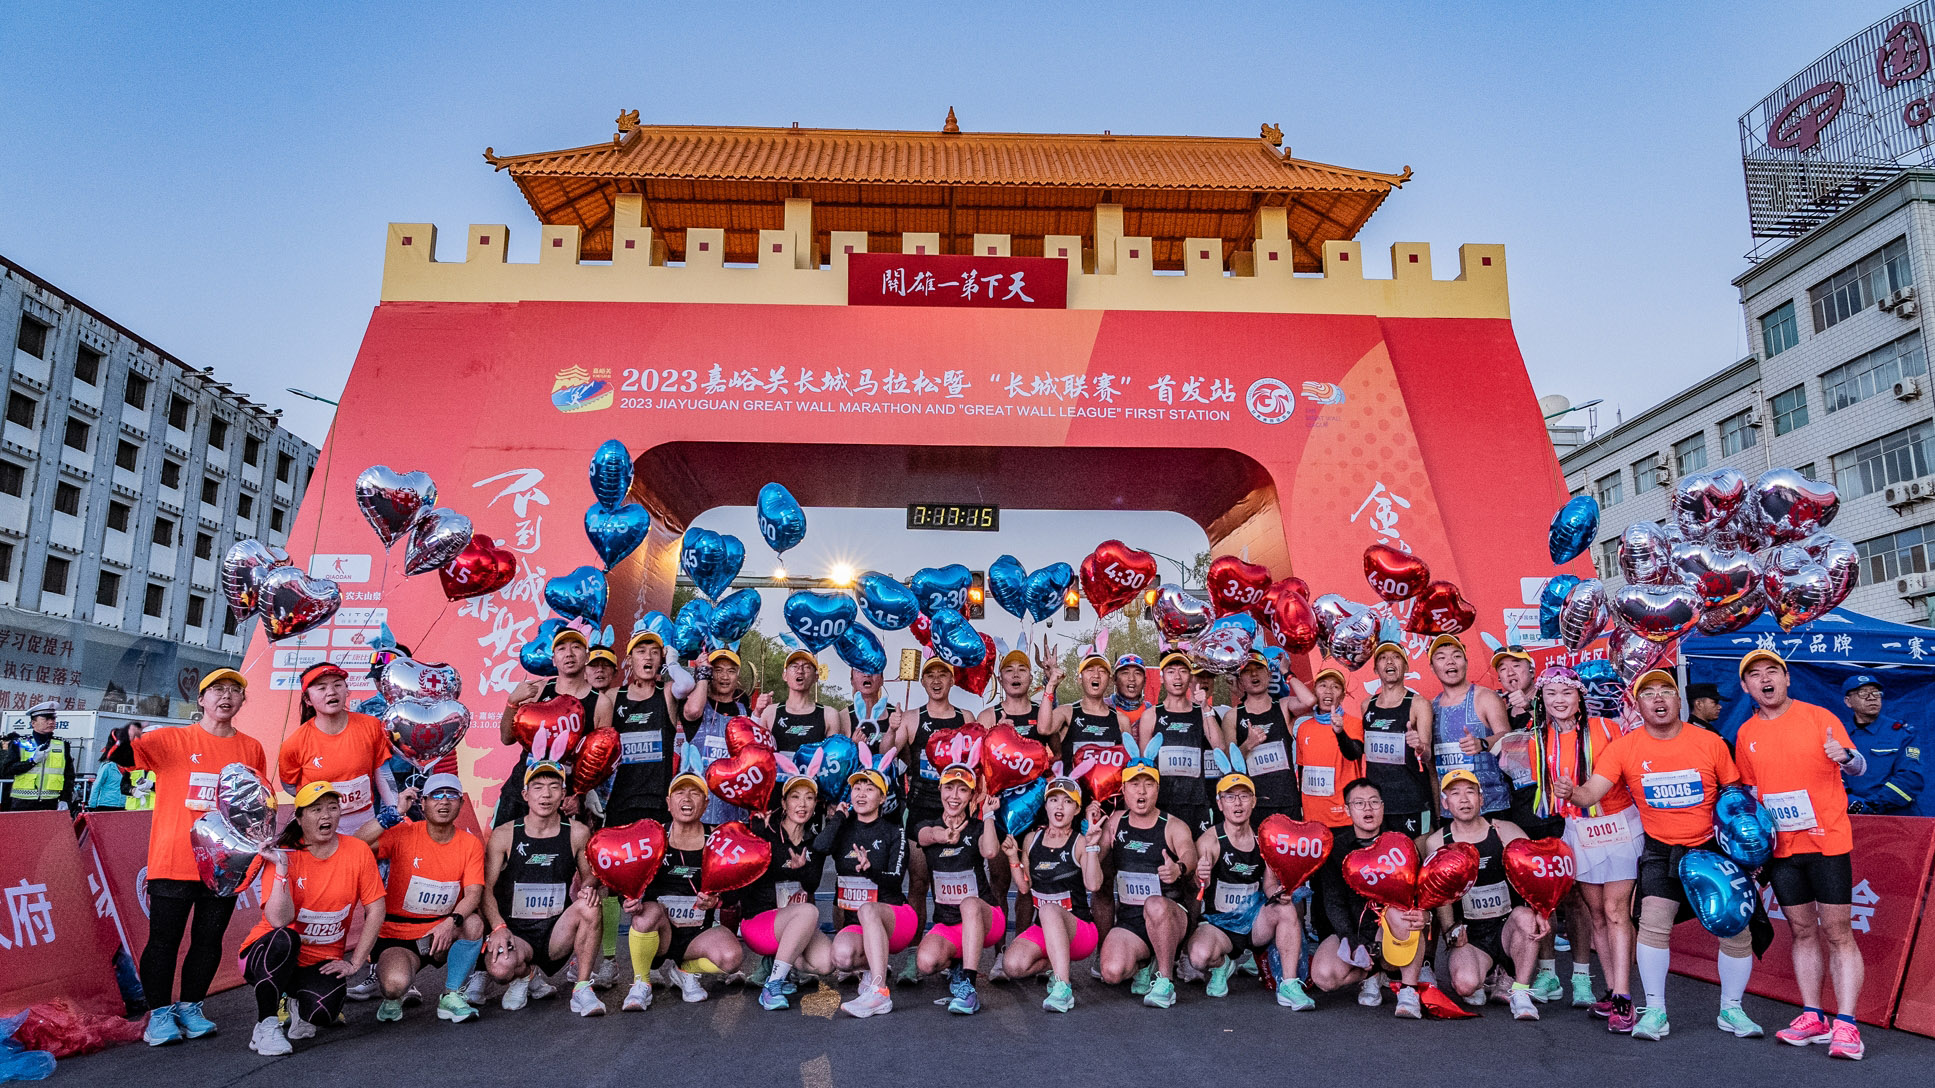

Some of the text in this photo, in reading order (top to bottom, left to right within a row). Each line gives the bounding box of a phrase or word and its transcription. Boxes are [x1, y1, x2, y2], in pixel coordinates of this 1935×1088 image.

[1148, 373, 1237, 405] 首发站
[619, 397, 653, 409] 2023
[655, 398, 741, 411] JIAYUGUAN
[743, 399, 793, 412] GREAT
[796, 401, 837, 413] WALL
[839, 402, 922, 415] MARATHON
[925, 403, 957, 416] AND
[1017, 405, 1057, 417] WALL
[1125, 408, 1167, 419] FIRST
[1169, 408, 1231, 421] STATION
[588, 513, 630, 534] 2:45
[914, 505, 993, 527] 7:17:15
[1104, 562, 1145, 589] 4:30
[1367, 570, 1409, 596] 4:00
[345, 591, 382, 601] 农夫山泉
[929, 587, 968, 610] 2:30
[1224, 580, 1264, 605] 3:30
[799, 617, 846, 638] 2:00
[3, 659, 83, 688] 执行促落实
[624, 742, 654, 755] 30441
[1370, 742, 1395, 754] 10586
[991, 742, 1035, 776] 4:30
[1082, 750, 1125, 768] 5:00
[1168, 756, 1193, 767] 10173
[1254, 752, 1279, 766] 10601
[1441, 753, 1465, 765] 31012
[718, 765, 764, 799] 5:30
[1652, 783, 1692, 799] 30046
[1586, 821, 1619, 838] 20101
[597, 837, 654, 871] 6:15
[705, 829, 746, 865] 6:15
[1275, 833, 1323, 859] 5:00
[1359, 847, 1407, 886] 5:30
[1531, 855, 1574, 878] 3:30
[417, 891, 449, 905] 10179
[842, 888, 869, 901] 40109
[941, 884, 968, 895] 20168
[1126, 883, 1151, 896] 10159
[1717, 860, 1755, 918] 2:15
[525, 896, 555, 908] 10145
[1470, 895, 1501, 910] 10320
[304, 921, 343, 936] 40292
